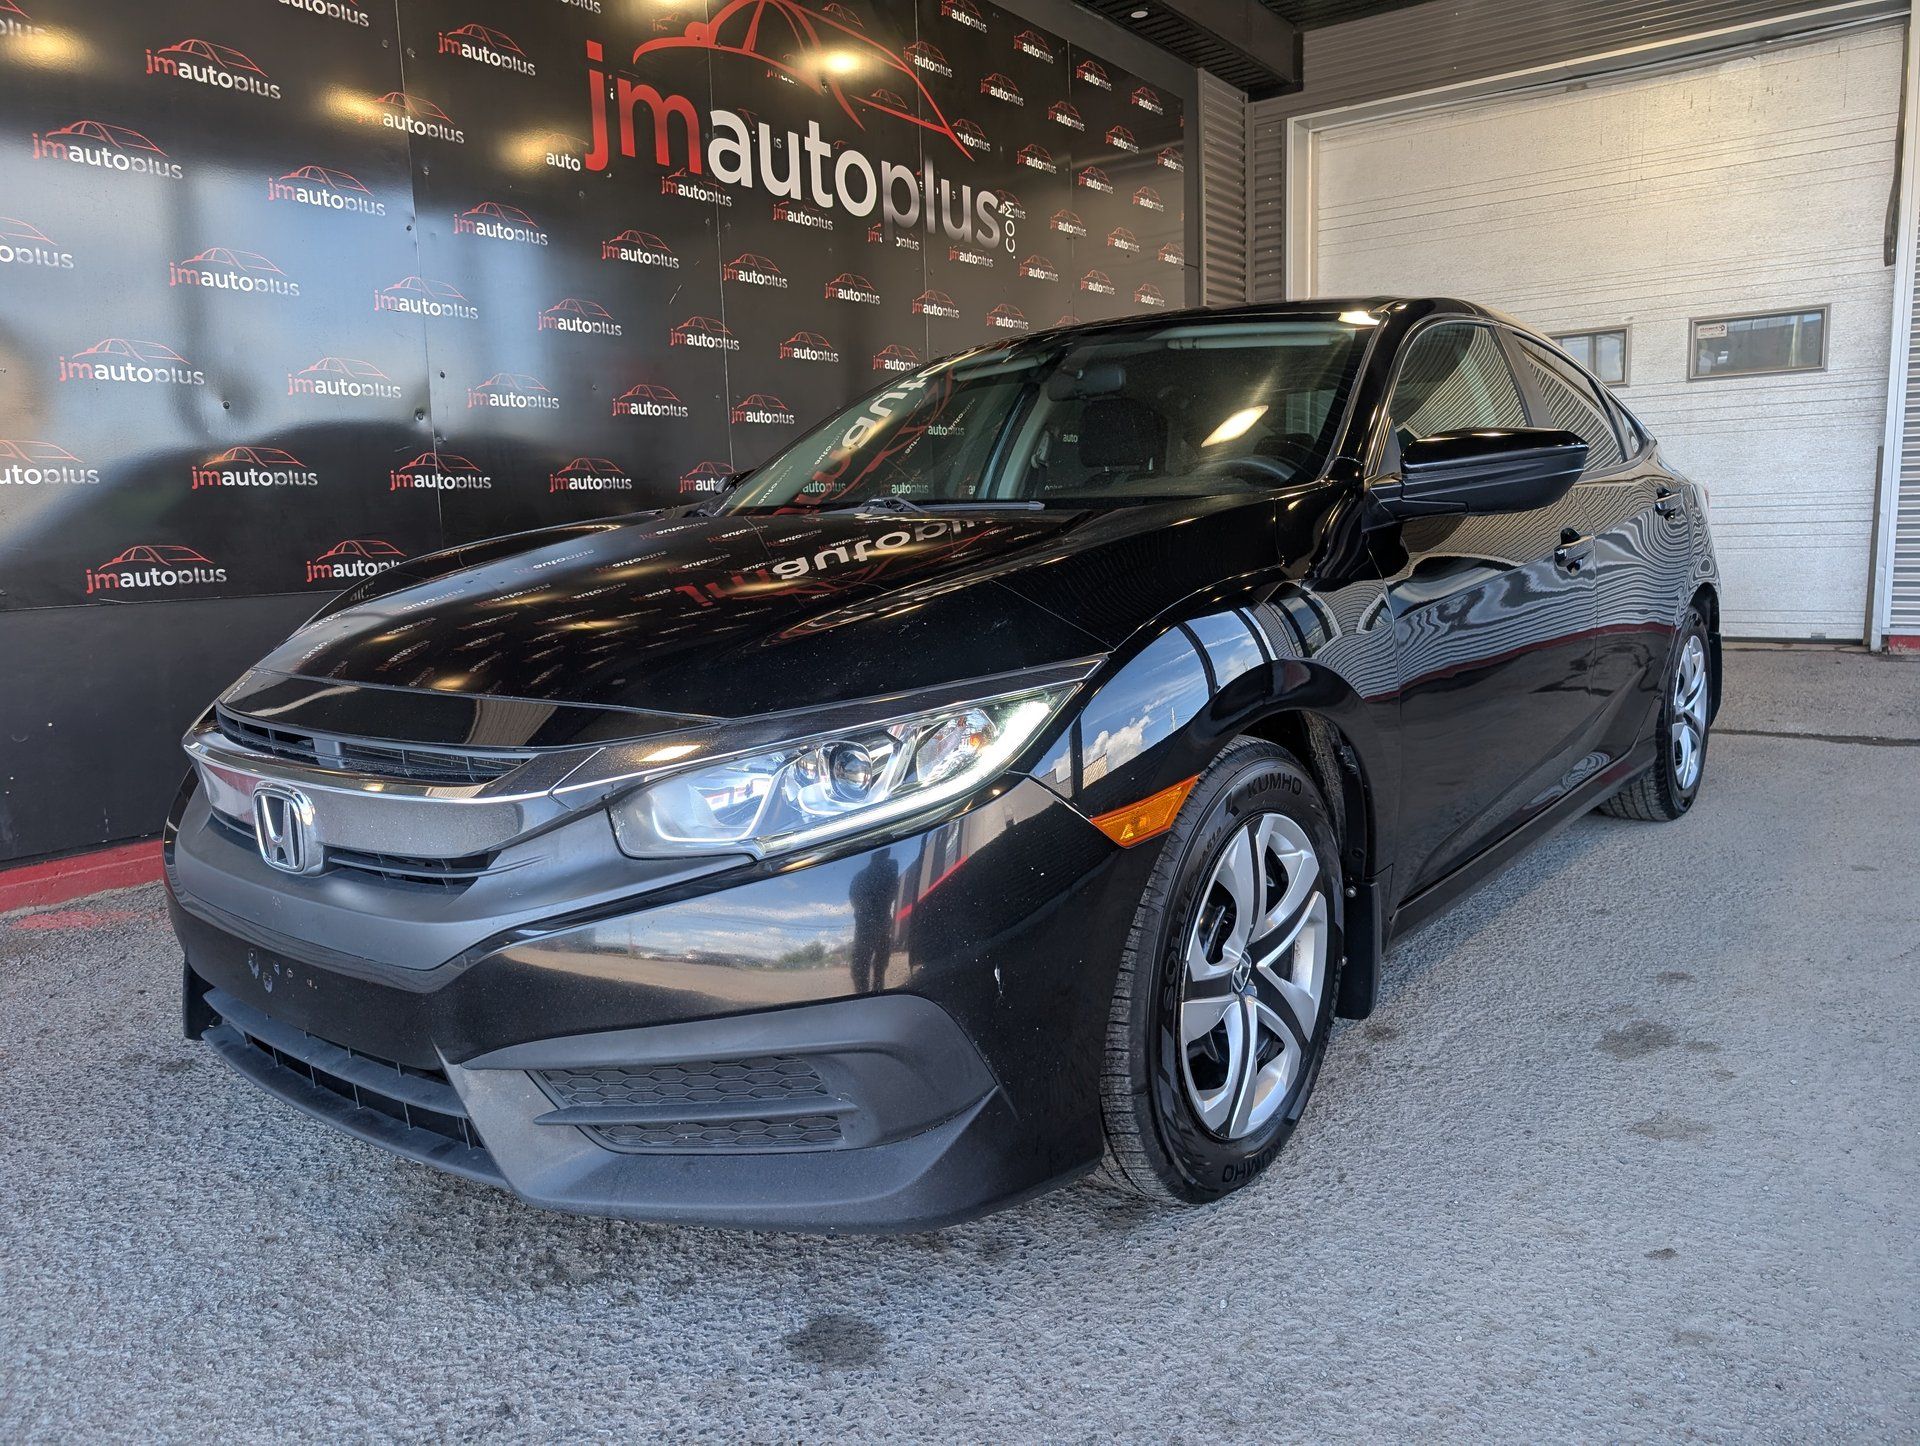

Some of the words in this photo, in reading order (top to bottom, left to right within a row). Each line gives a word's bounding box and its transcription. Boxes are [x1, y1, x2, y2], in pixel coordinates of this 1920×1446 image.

[941, 1, 987, 33] jmautoplus
[438, 32, 535, 76] jmautoplus
[1014, 34, 1053, 64] jmautoplus
[145, 48, 282, 100] jmautoplus
[904, 50, 952, 78] jmautoplus
[1076, 68, 1112, 91] jmautoplus
[980, 79, 1024, 107] jmautoplus
[1132, 92, 1163, 116] jmautoplus
[1048, 107, 1085, 132] jmautoplus
[585, 40, 1000, 248] jmautoplus
[1106, 133, 1139, 154] jmautoplus
[32, 132, 183, 180] jmautoplus
[1017, 151, 1056, 175] jmautoplus
[661, 177, 732, 207] jmautoplus
[1078, 173, 1113, 195] jmautoplus
[268, 177, 386, 217] jmautoplus
[1132, 194, 1164, 213] jmautoplus
[773, 204, 833, 231] jmautoplus
[1050, 216, 1086, 238] jmautoplus
[453, 214, 548, 247] jmautoplus
[1107, 234, 1140, 253] jmautoplus
[601, 243, 680, 269] jmautoplus
[949, 247, 993, 268] jmautoplus
[169, 261, 300, 296] jmautoplus
[723, 264, 788, 289] jmautoplus
[1019, 263, 1058, 283] jmautoplus
[825, 283, 880, 305] jmautoplus
[1081, 277, 1115, 296] jmautoplus
[374, 290, 479, 320] jmautoplus
[912, 299, 960, 319] jmautoplus
[1134, 291, 1165, 307] jmautoplus
[538, 312, 622, 336] jmautoplus
[987, 312, 1028, 330] jmautoplus
[670, 328, 740, 351] jmautoplus
[780, 343, 839, 363] jmautoplus
[59, 357, 205, 385] jmautoplus
[288, 373, 401, 399] jmautoplus
[467, 389, 559, 409] jmautoplus
[612, 398, 689, 417] jmautoplus
[731, 408, 795, 425] jmautoplus
[192, 466, 318, 490] jmautoplus
[390, 470, 492, 492] jmautoplus
[550, 473, 632, 493] jmautoplus
[86, 566, 227, 594] jmautoplus
[1248, 773, 1303, 797] KUMHO
